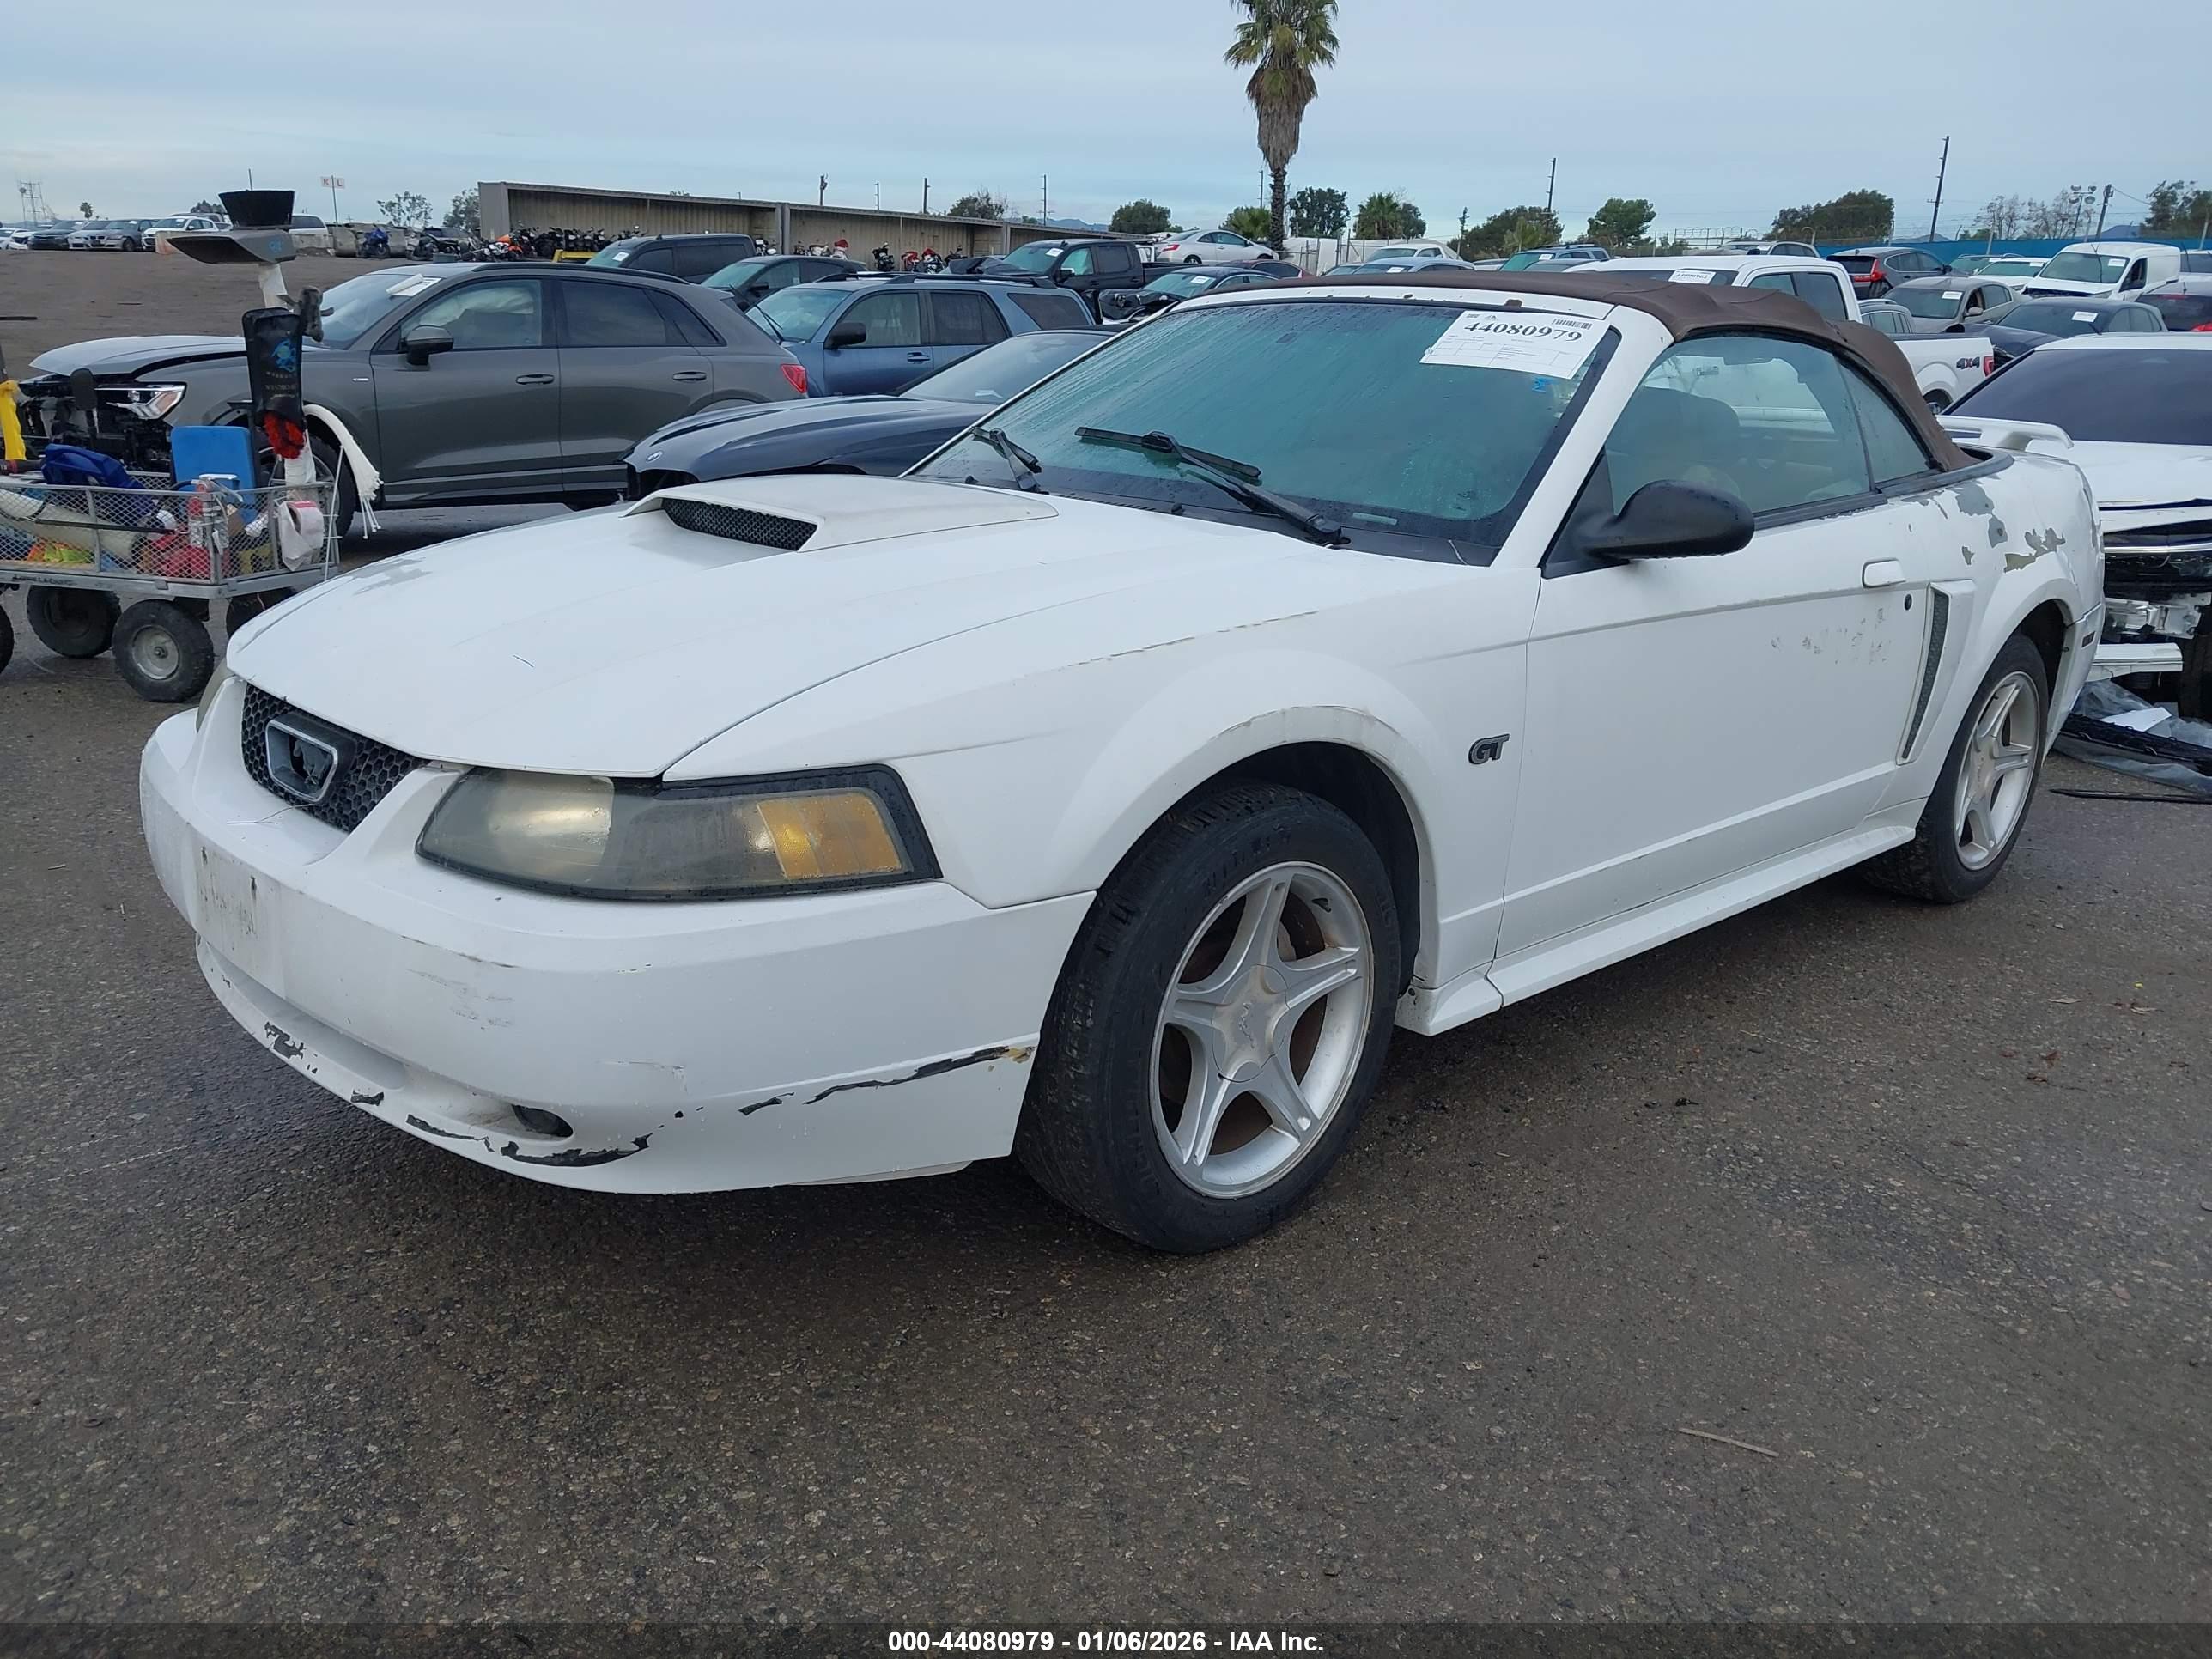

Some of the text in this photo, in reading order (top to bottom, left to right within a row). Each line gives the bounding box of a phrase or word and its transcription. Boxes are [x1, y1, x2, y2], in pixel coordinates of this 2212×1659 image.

[323, 178, 343, 187] K L
[1464, 322, 1582, 341] 44080979
[1468, 733, 1510, 765] GT
